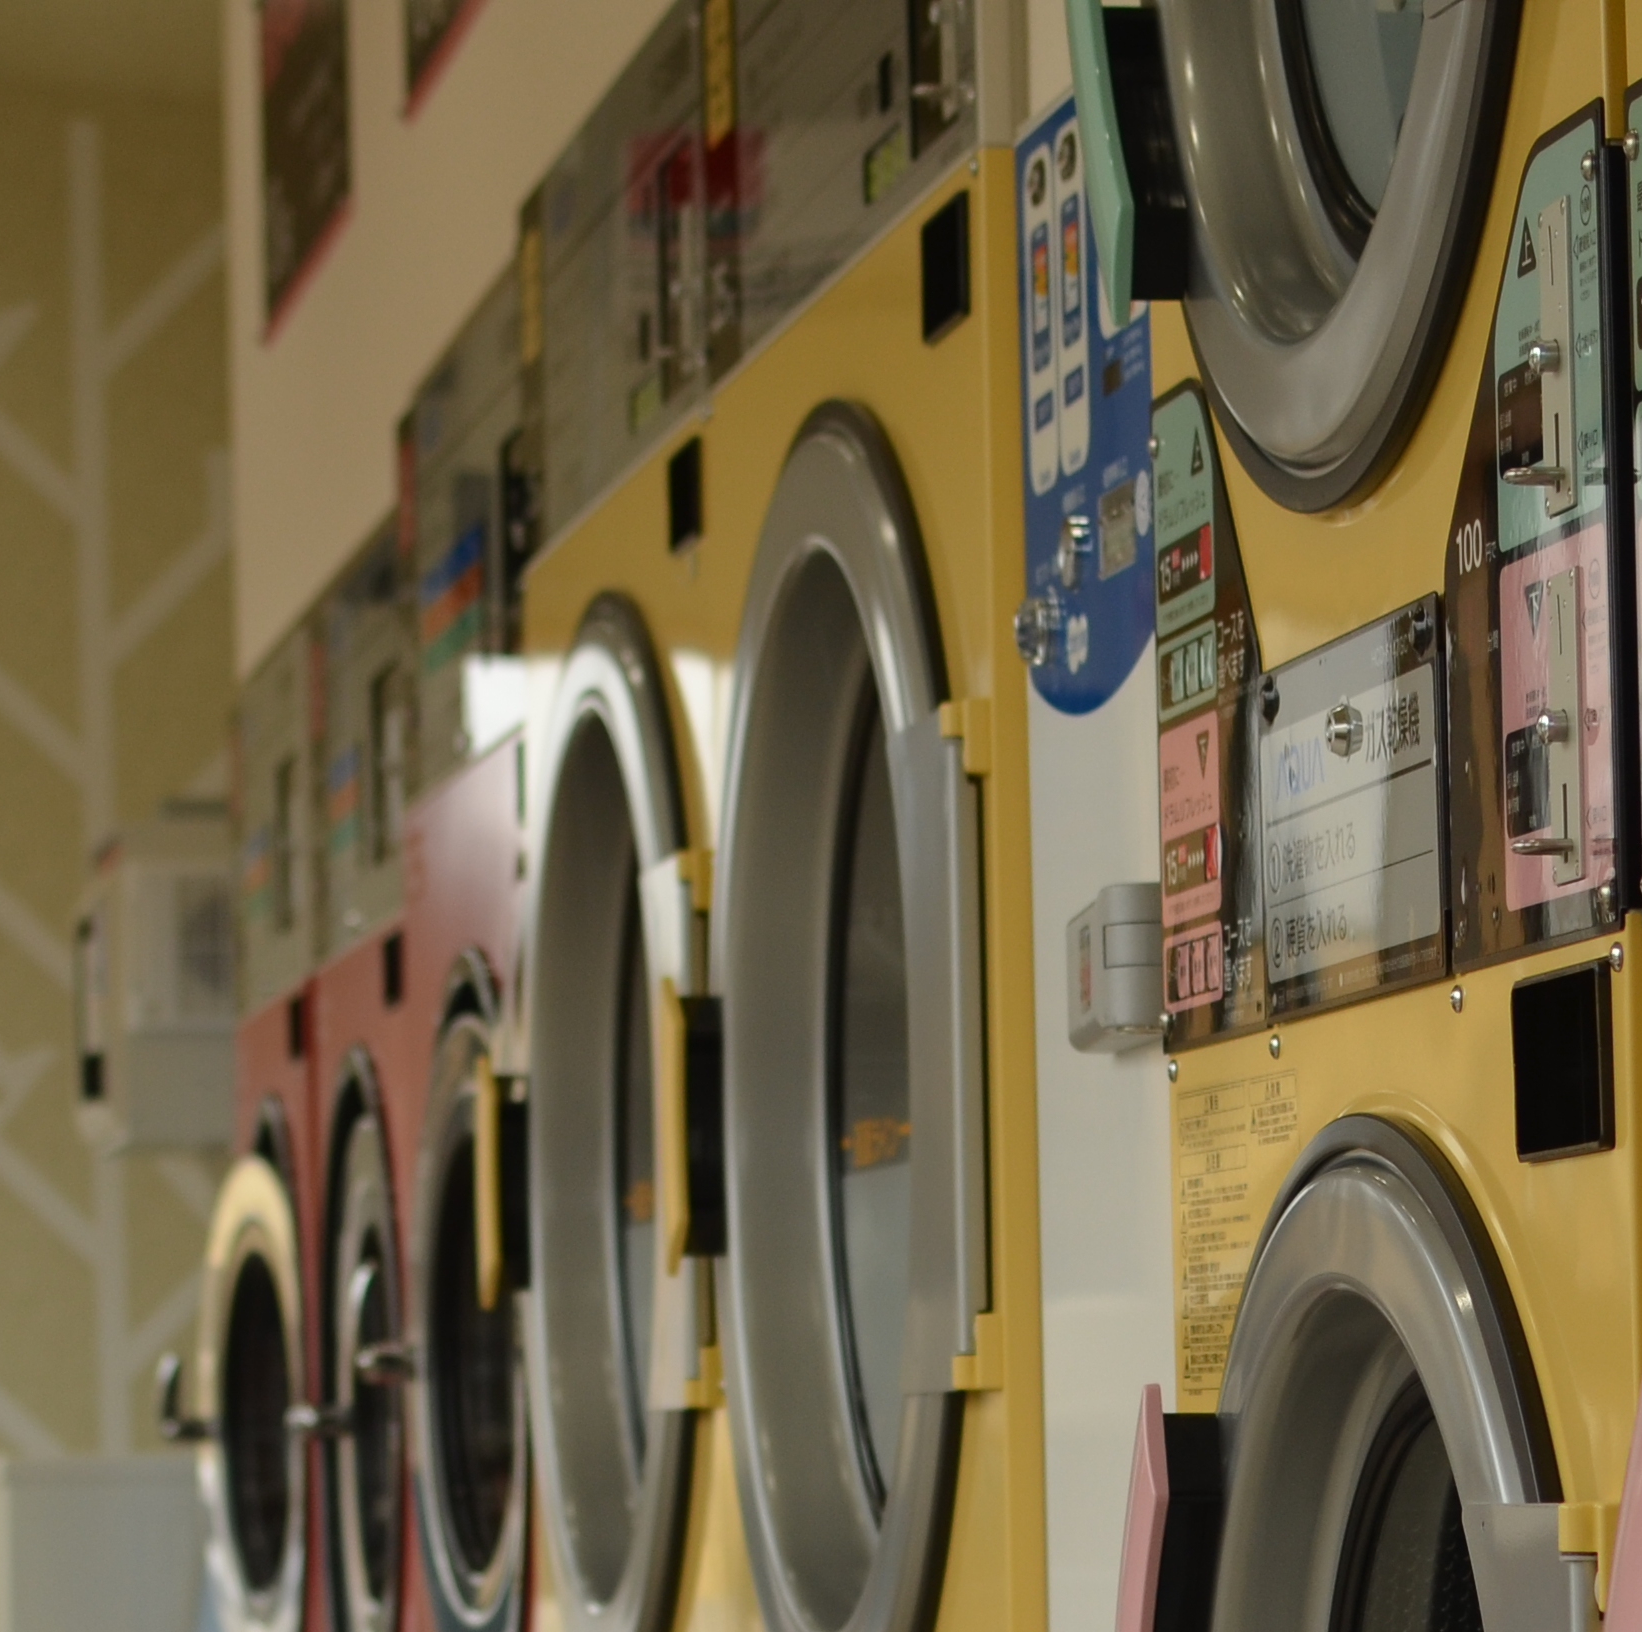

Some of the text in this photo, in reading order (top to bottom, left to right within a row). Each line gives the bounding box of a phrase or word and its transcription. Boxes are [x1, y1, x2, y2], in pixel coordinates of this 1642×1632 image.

[1521, 230, 1532, 267] 上
[1456, 518, 1483, 575] 100
[1159, 555, 1171, 594] 15
[1218, 610, 1245, 648] コースを
[1275, 735, 1325, 802] AQUA
[1165, 849, 1178, 887] 15
[1224, 917, 1252, 952] コースを
